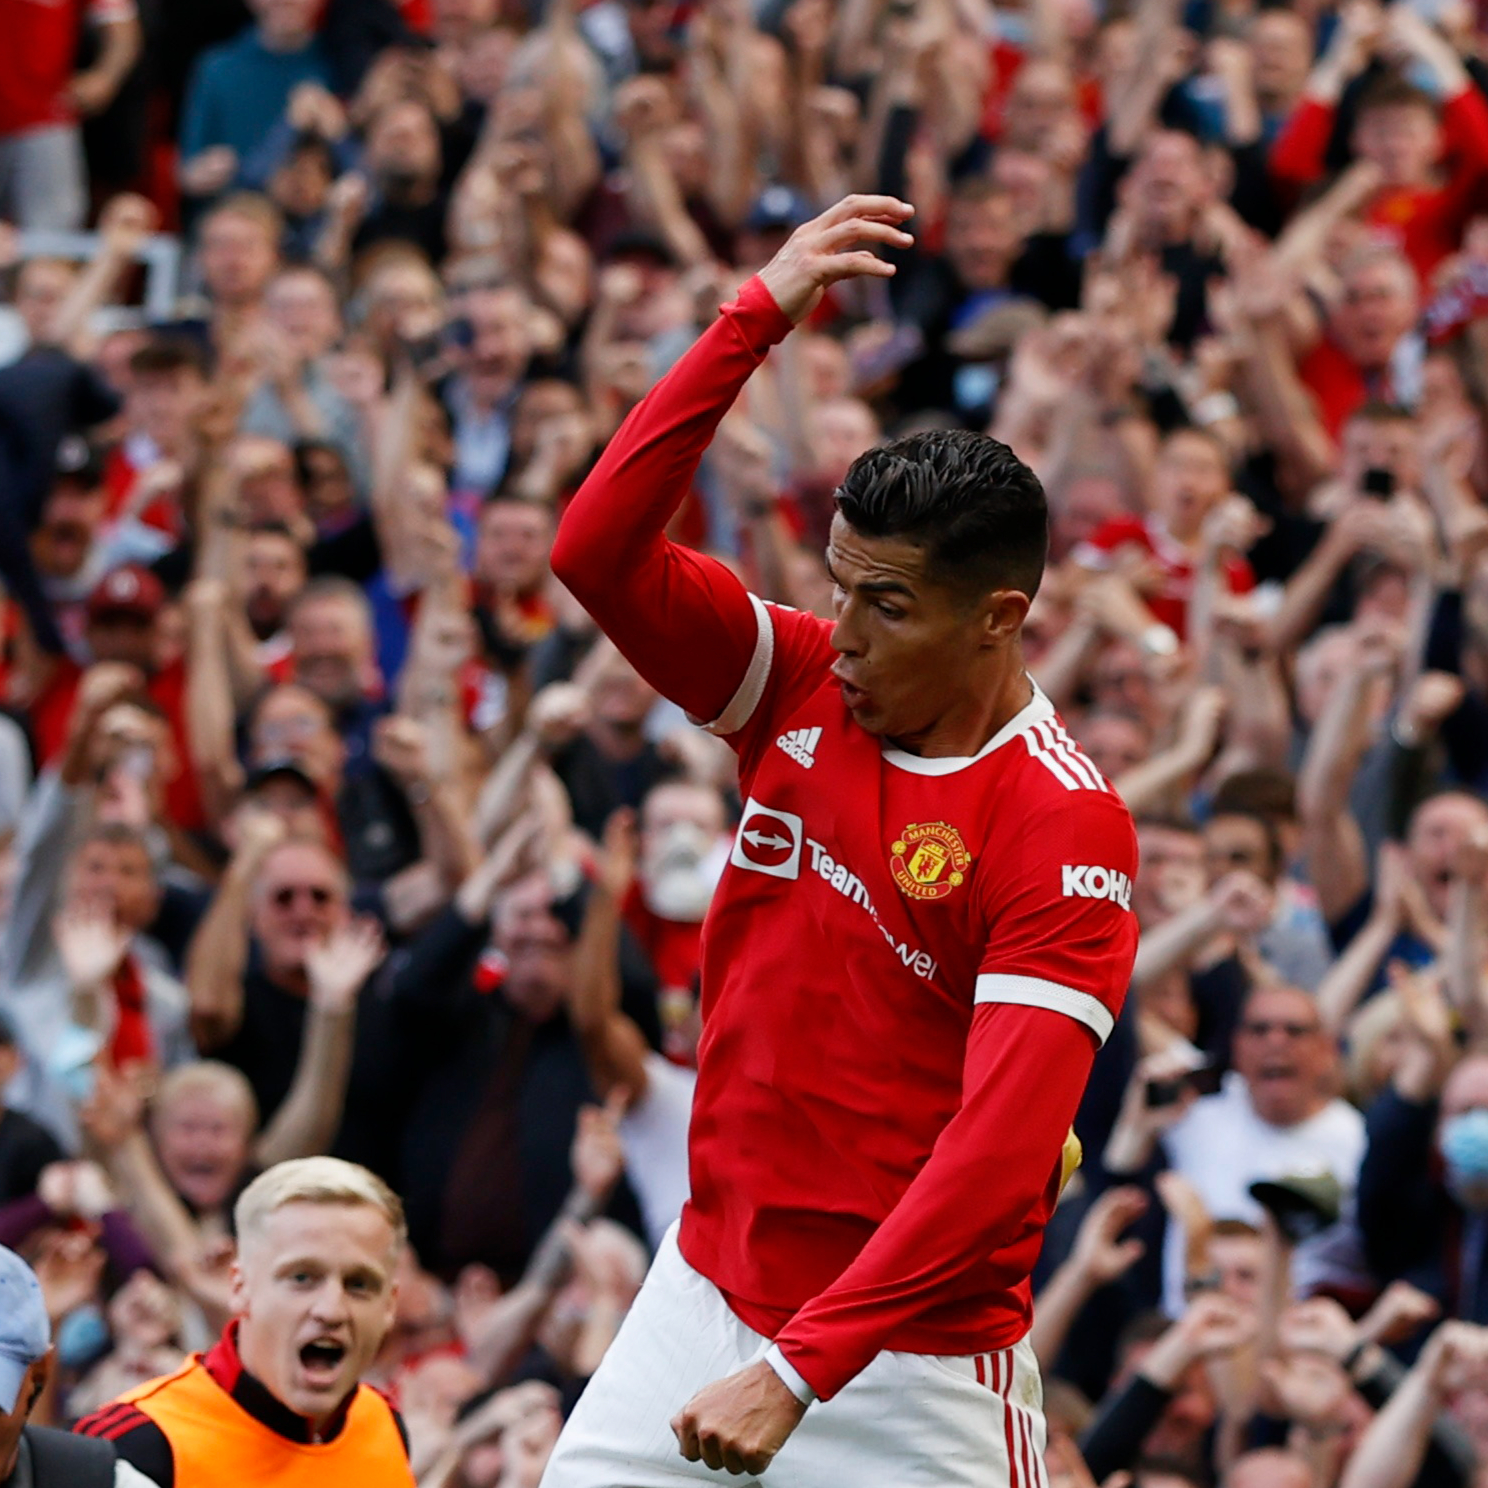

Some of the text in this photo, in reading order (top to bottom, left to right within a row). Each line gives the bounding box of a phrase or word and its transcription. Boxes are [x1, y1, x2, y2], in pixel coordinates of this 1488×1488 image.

[776, 733, 815, 769] adidas
[908, 826, 964, 866] MANCHESTER
[896, 870, 938, 896] UNITED
[1061, 864, 1132, 912] KOHL
